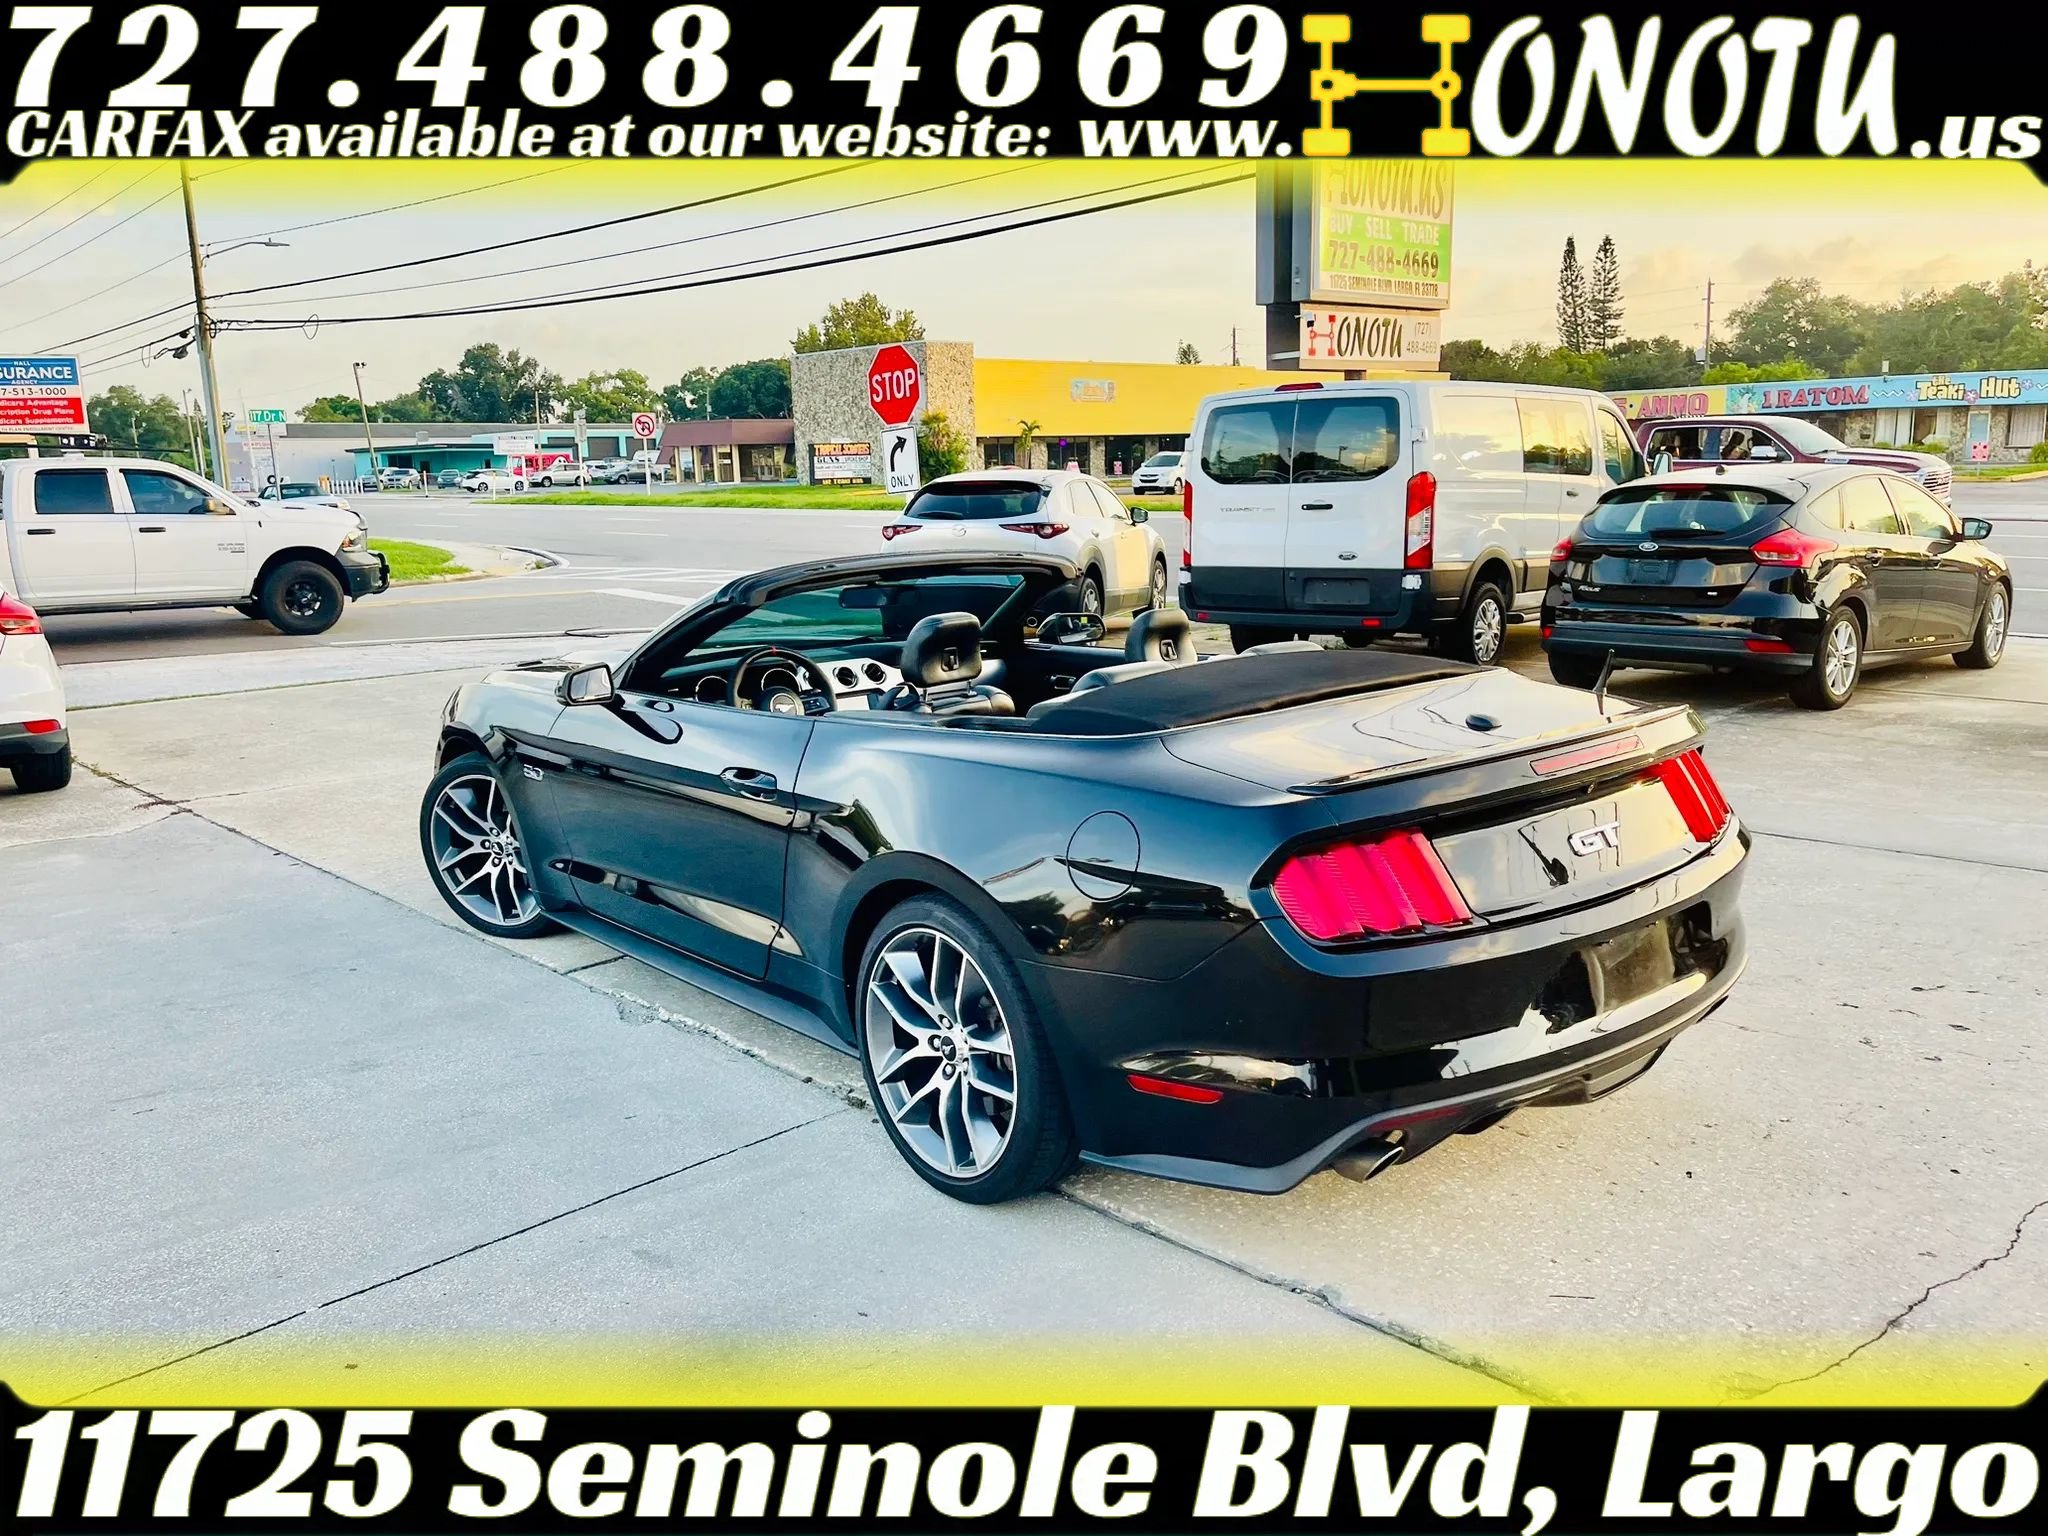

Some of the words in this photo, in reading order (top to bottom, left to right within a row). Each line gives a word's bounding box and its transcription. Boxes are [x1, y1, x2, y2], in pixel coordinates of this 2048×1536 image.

[1329, 213, 1353, 235] BUY
[1365, 216, 1393, 240] SELL
[1401, 221, 1440, 246] TRADE
[1328, 240, 1439, 278] 727-488-4669
[871, 367, 916, 403] STOP
[1980, 376, 2021, 399] Hut
[1637, 393, 1709, 417] AMMO
[890, 474, 914, 488] ONLY
[1568, 821, 1620, 857] GT
